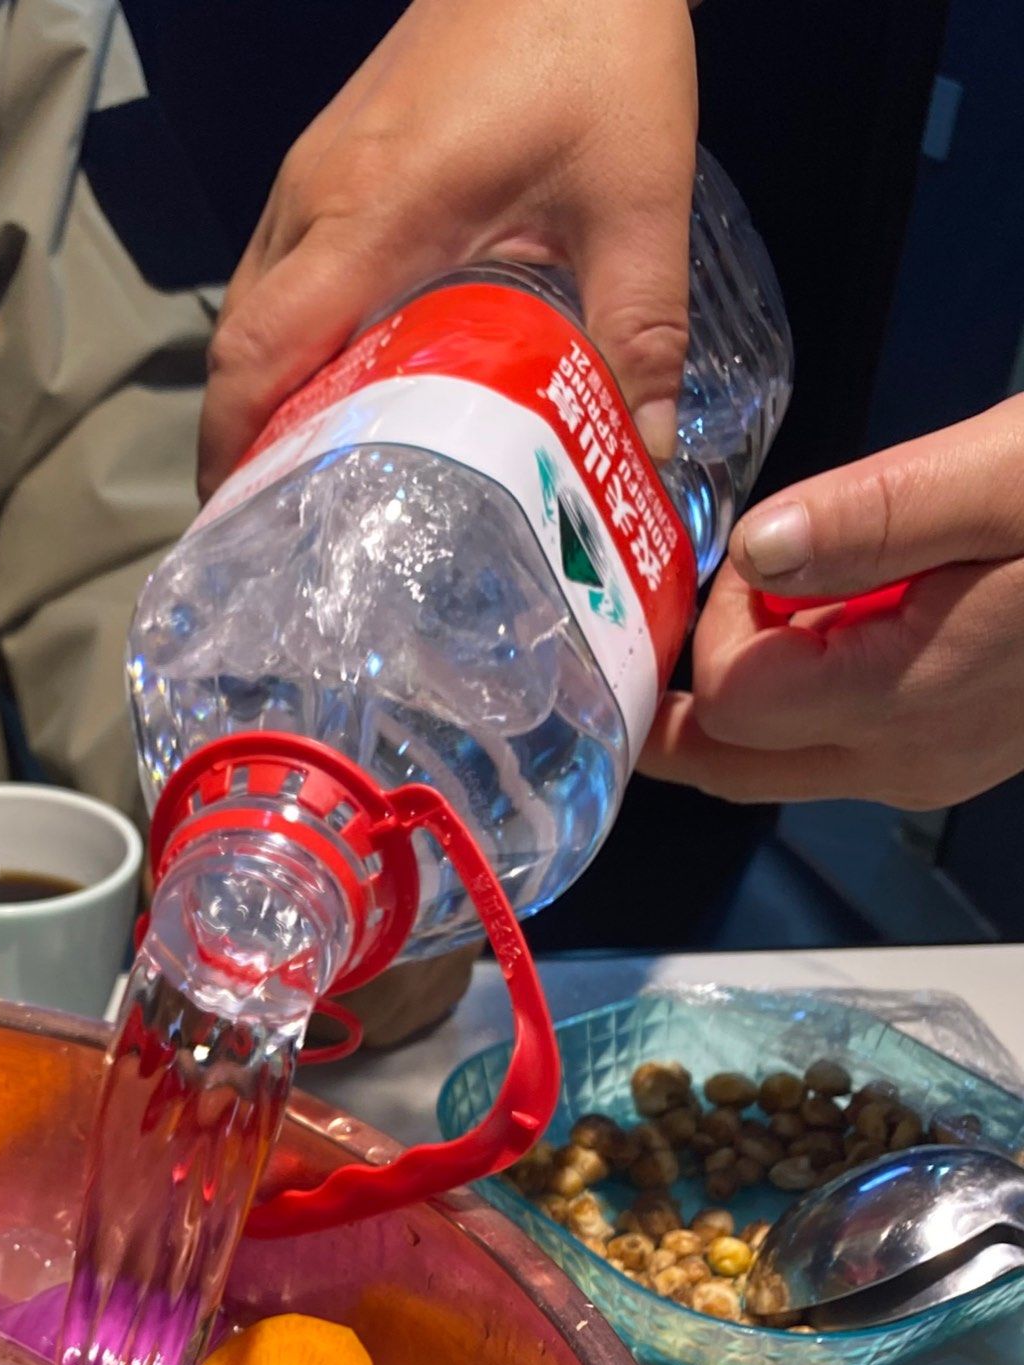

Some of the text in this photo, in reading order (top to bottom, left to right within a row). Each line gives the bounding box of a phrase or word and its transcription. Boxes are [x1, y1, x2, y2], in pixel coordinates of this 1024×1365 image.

[546, 371, 663, 592] 农夫山泉
[559, 355, 671, 567] NONGFU SPRING
